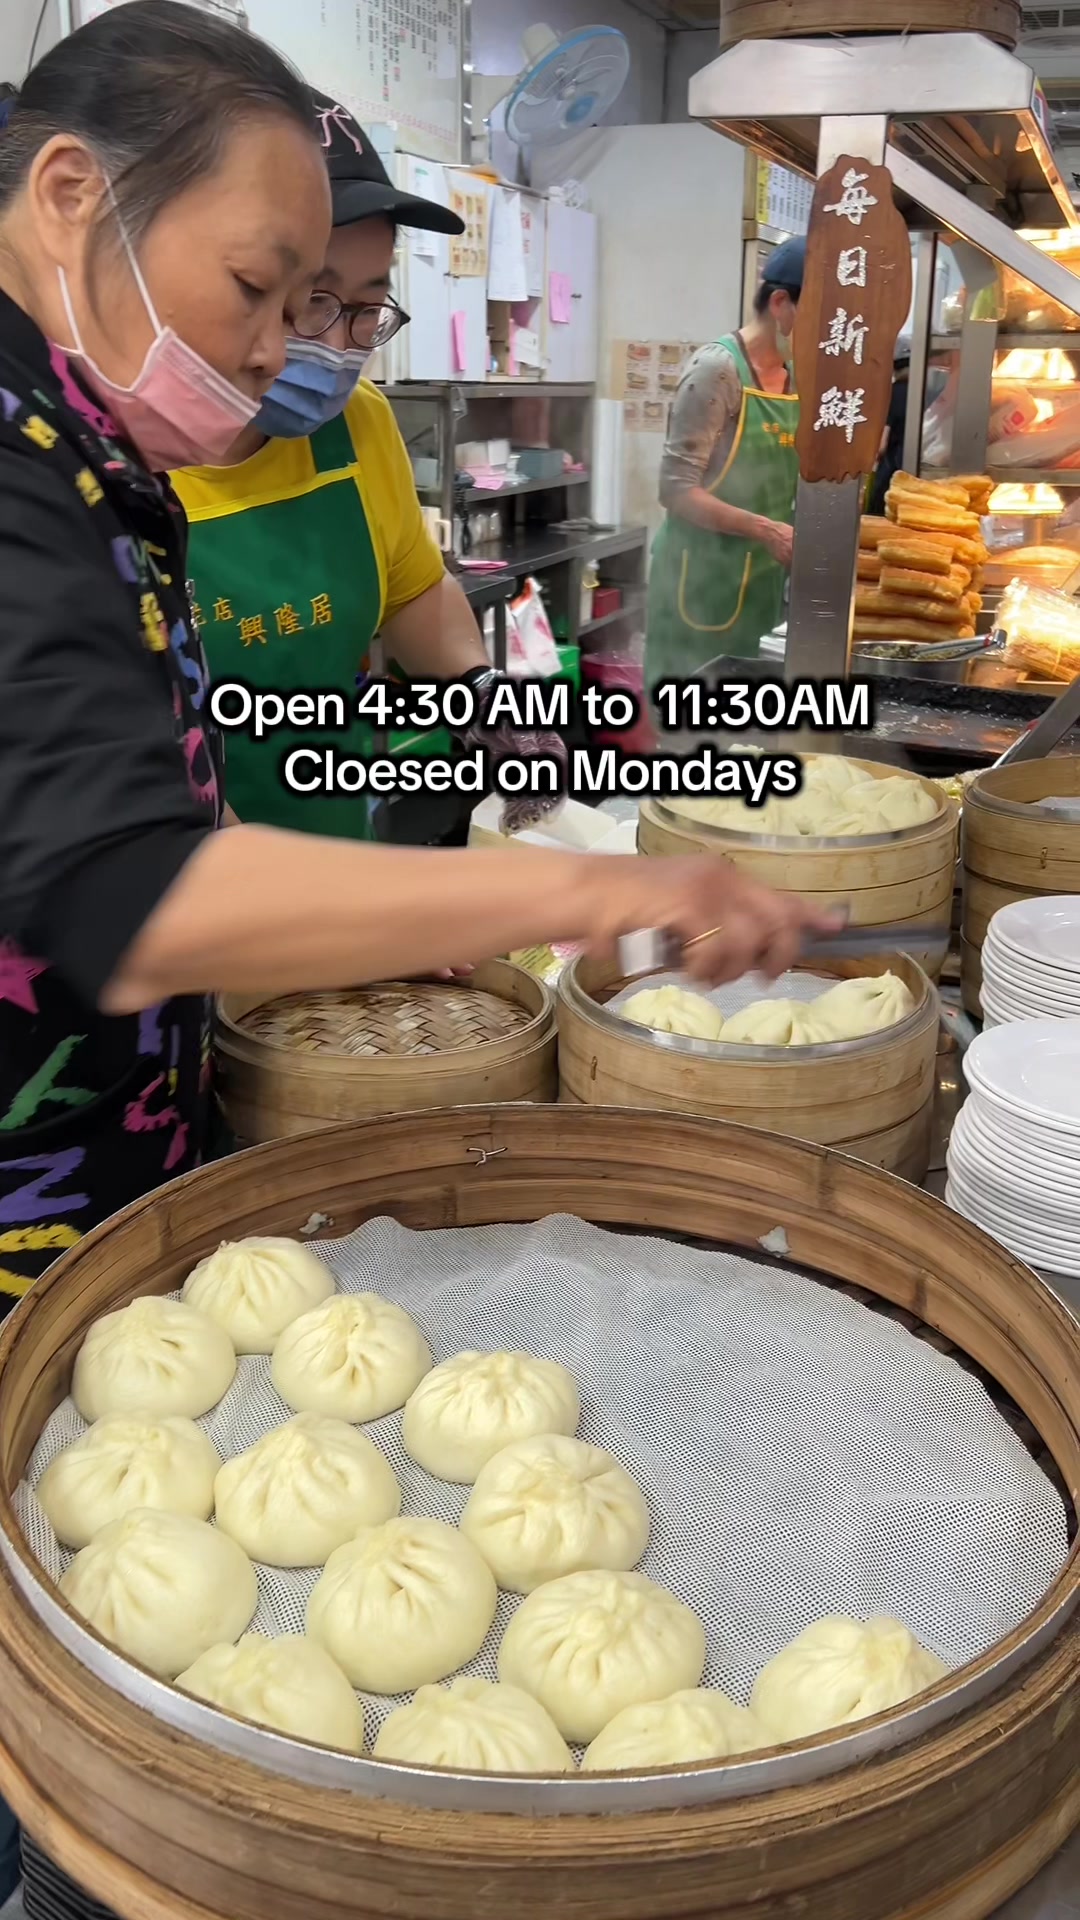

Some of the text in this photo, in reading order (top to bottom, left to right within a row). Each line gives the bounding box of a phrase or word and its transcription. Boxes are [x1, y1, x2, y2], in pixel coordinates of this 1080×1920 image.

[813, 167, 878, 443] 每日新鮮
[236, 592, 332, 647] 興隆居
